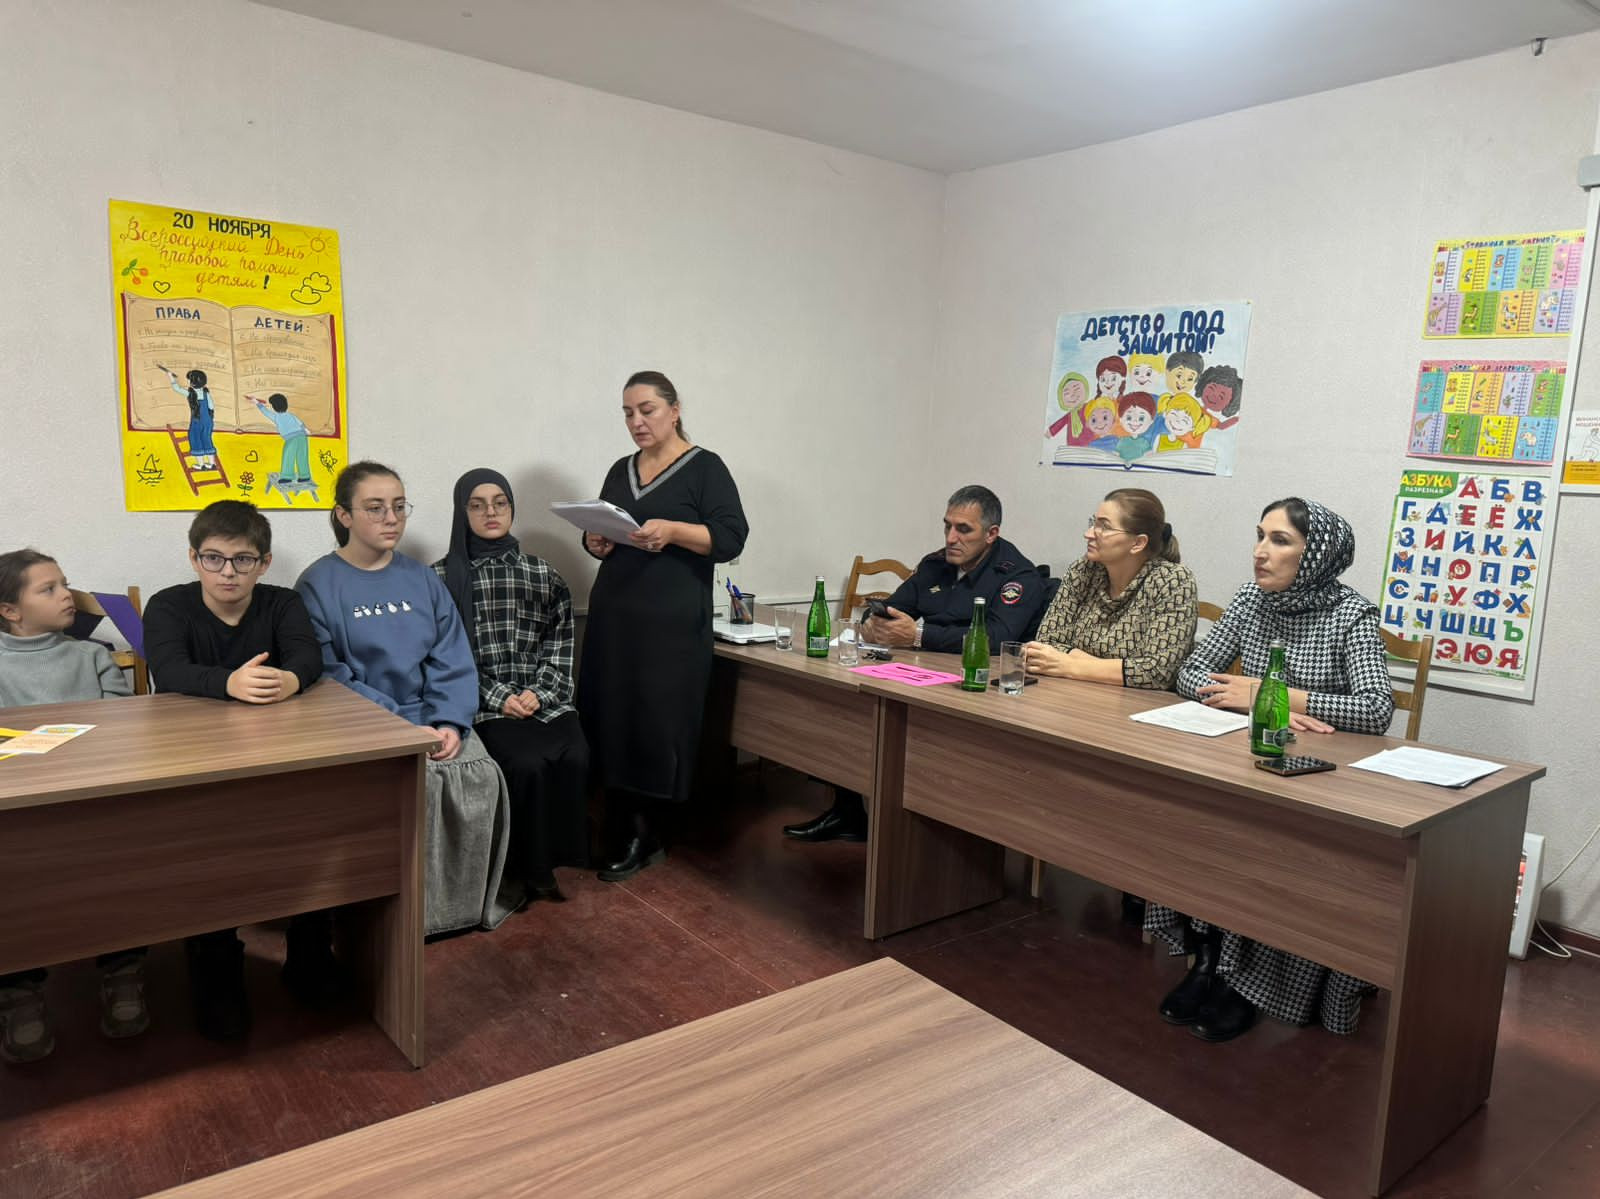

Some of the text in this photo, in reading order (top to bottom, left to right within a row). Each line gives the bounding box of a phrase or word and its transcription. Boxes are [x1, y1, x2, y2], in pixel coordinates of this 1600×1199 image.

[173, 212, 271, 240] 20 НОЯБРЯ
[264, 236, 304, 260] День
[156, 307, 201, 320] ПРАВА
[1080, 310, 1225, 341] ДЕТСТВО ПОД
[1117, 331, 1216, 357] ЗАЩИТОЙ!
[1401, 473, 1453, 488] АЗБУКА
[1458, 477, 1543, 502] А Б В
[1401, 501, 1543, 531] Г Д Е Ё Ж
[1399, 527, 1536, 560] З И Й К Л
[1392, 553, 1531, 586] М Н О П Р
[1389, 579, 1528, 613] С Т У Ф Х
[1384, 604, 1524, 642] Ц Ч Ш Щ Ъ
[1436, 638, 1519, 670] Э Ю Я
